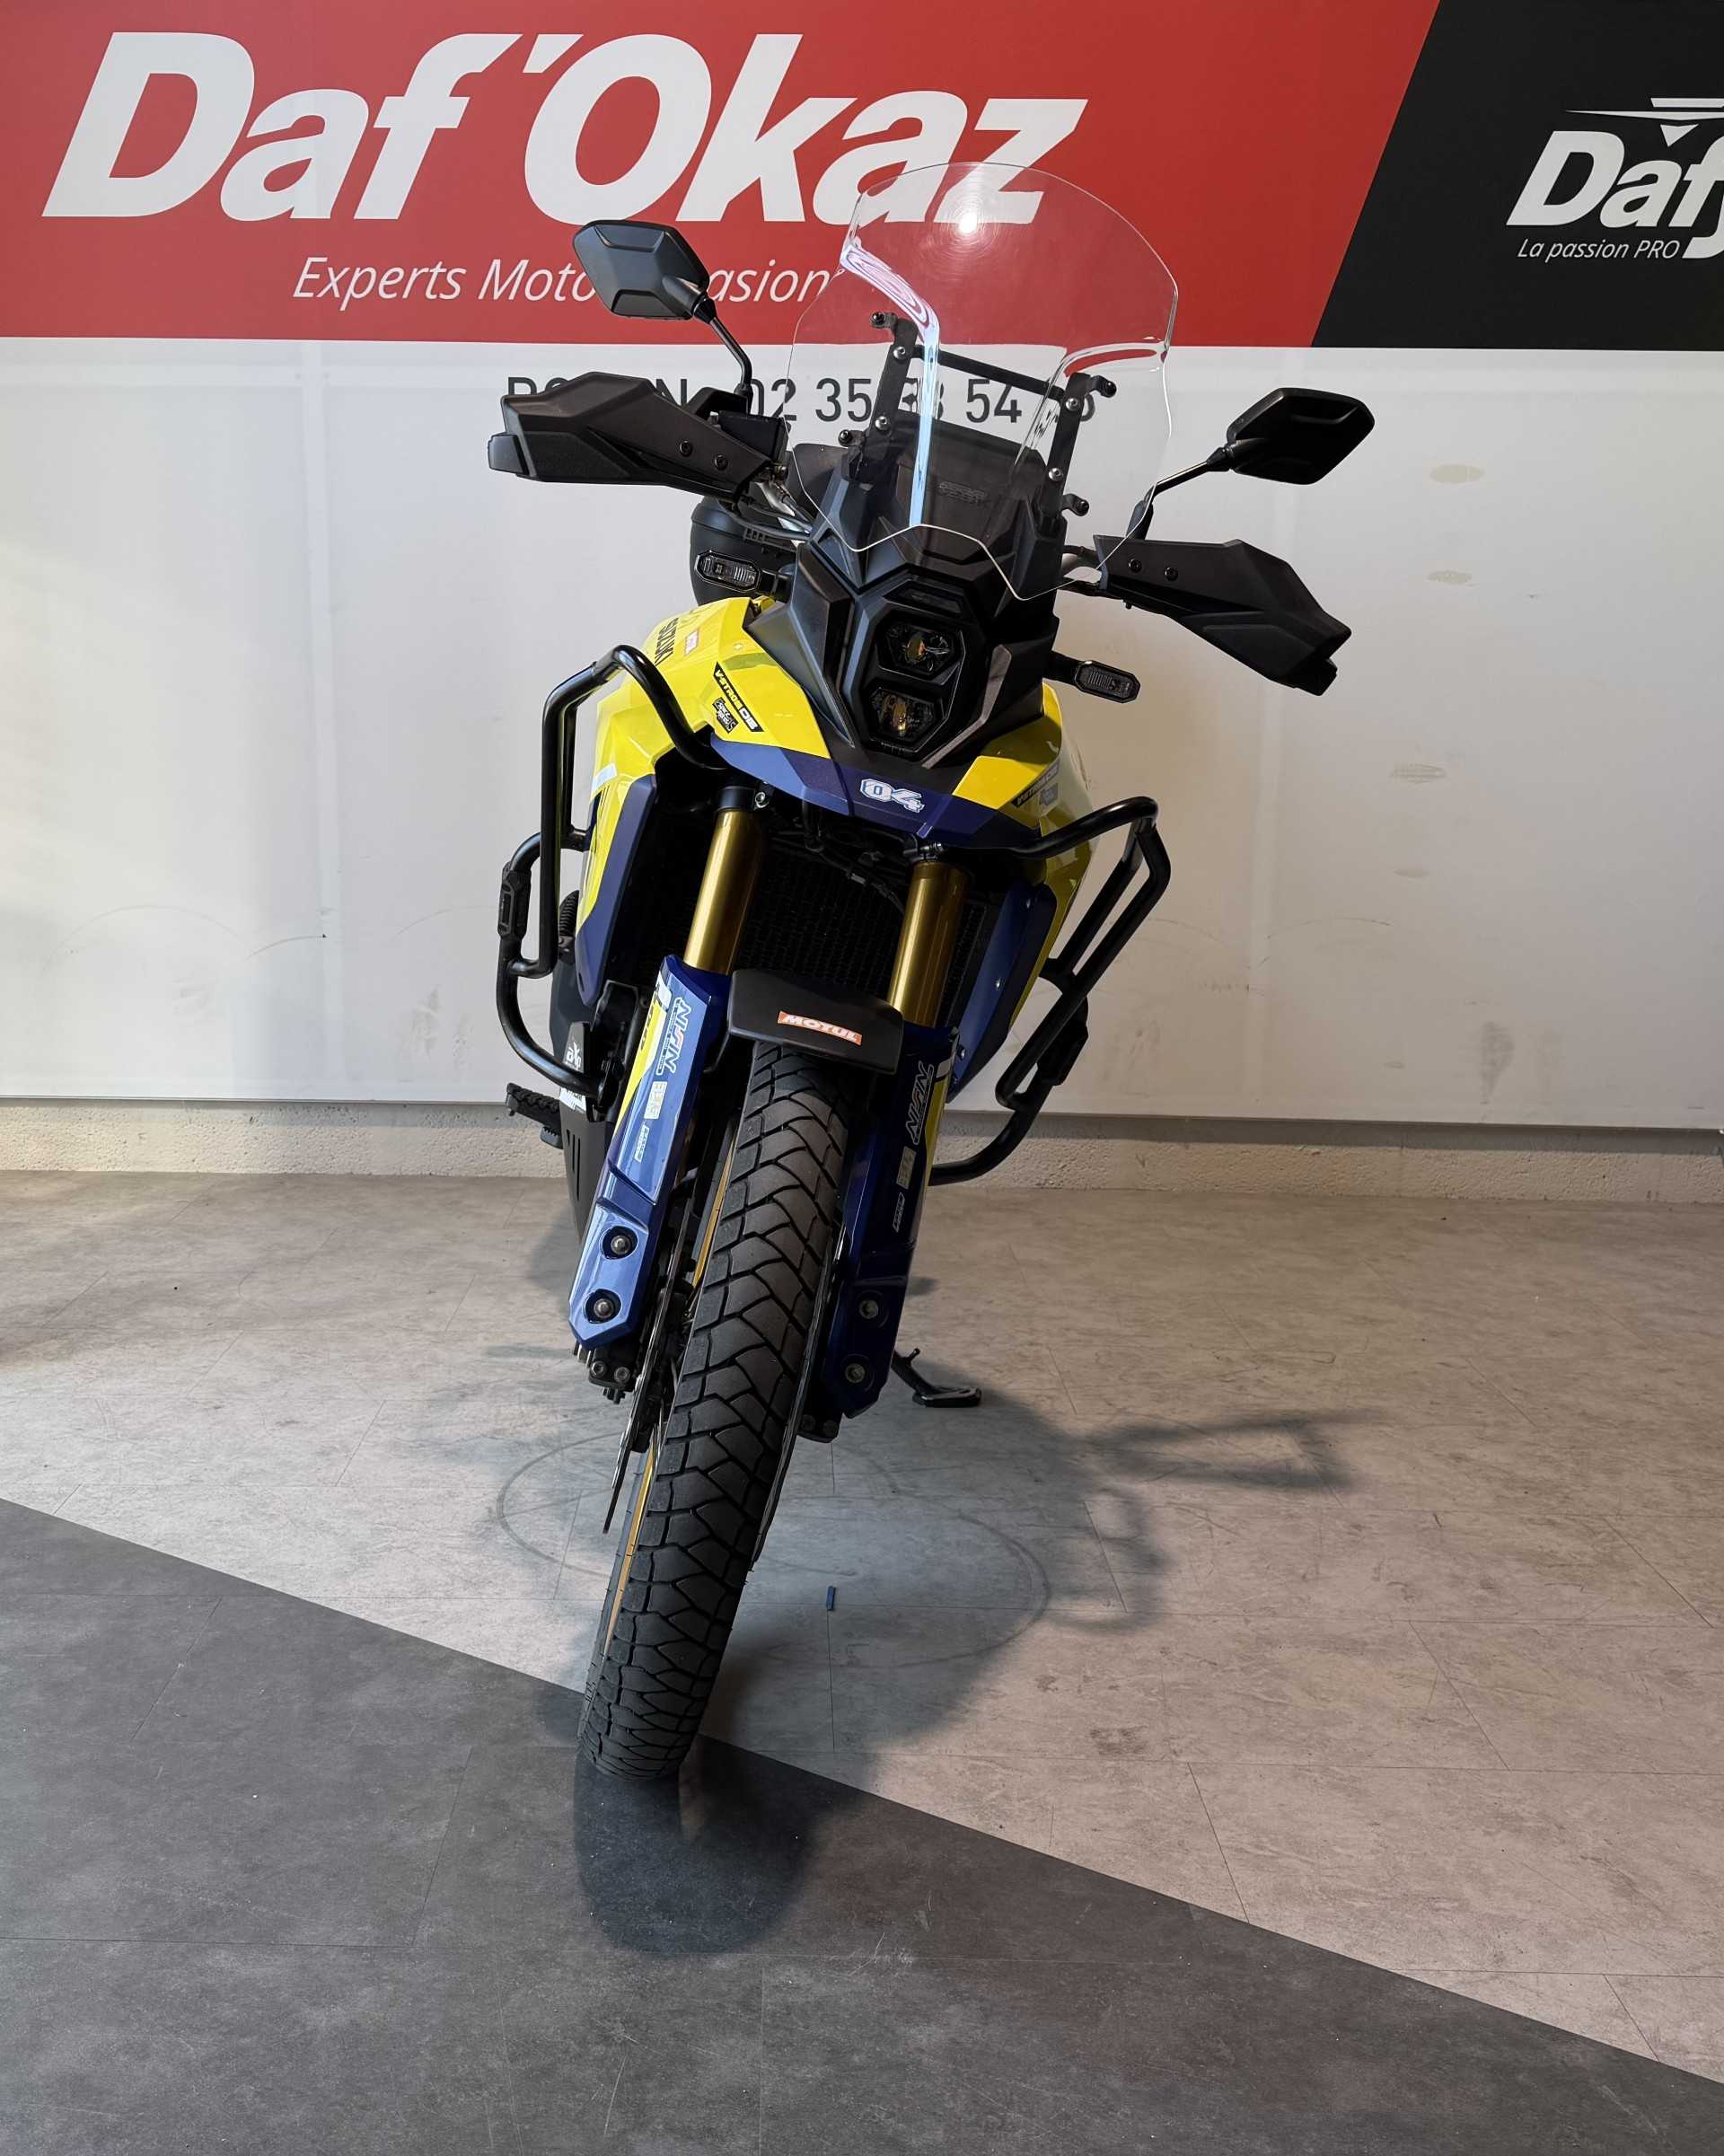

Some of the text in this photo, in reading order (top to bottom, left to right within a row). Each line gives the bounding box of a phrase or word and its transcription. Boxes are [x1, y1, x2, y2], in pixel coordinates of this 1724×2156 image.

[1517, 238, 1681, 263] La passion PRO
[293, 256, 467, 312] Experts
[478, 258, 595, 302] Moto
[815, 377, 872, 422] 35
[966, 378, 1022, 423] 54
[860, 779, 925, 814] 04
[780, 1013, 858, 1044] MOTUL
